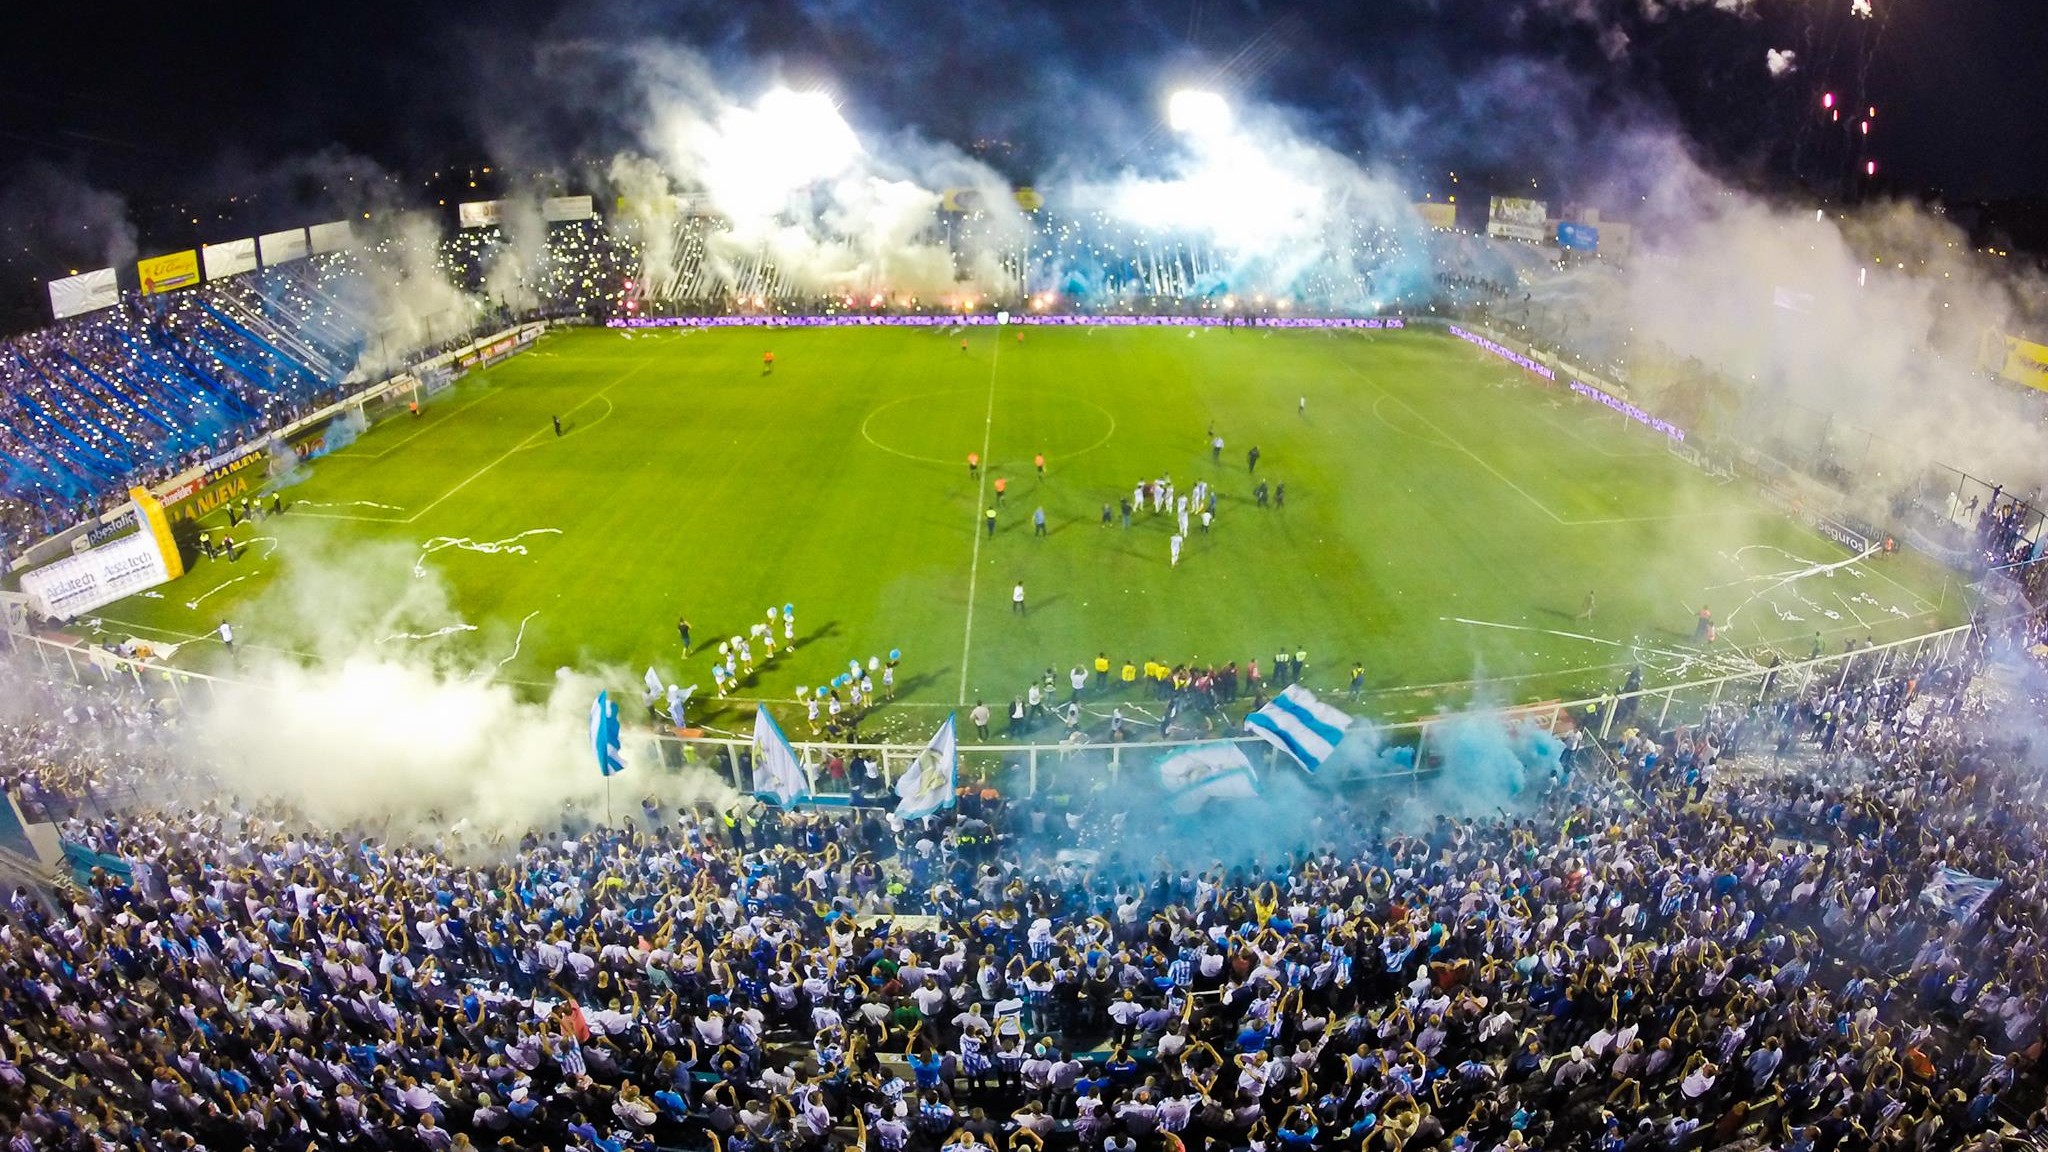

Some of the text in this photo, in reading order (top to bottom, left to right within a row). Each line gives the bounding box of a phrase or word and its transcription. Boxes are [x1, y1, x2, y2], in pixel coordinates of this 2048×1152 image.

[214, 467, 230, 480] LA
[229, 451, 262, 473] NUEVA
[196, 476, 248, 515] NUEVA
[1818, 520, 1865, 553] seguros
[747, 903, 759, 913] 10
